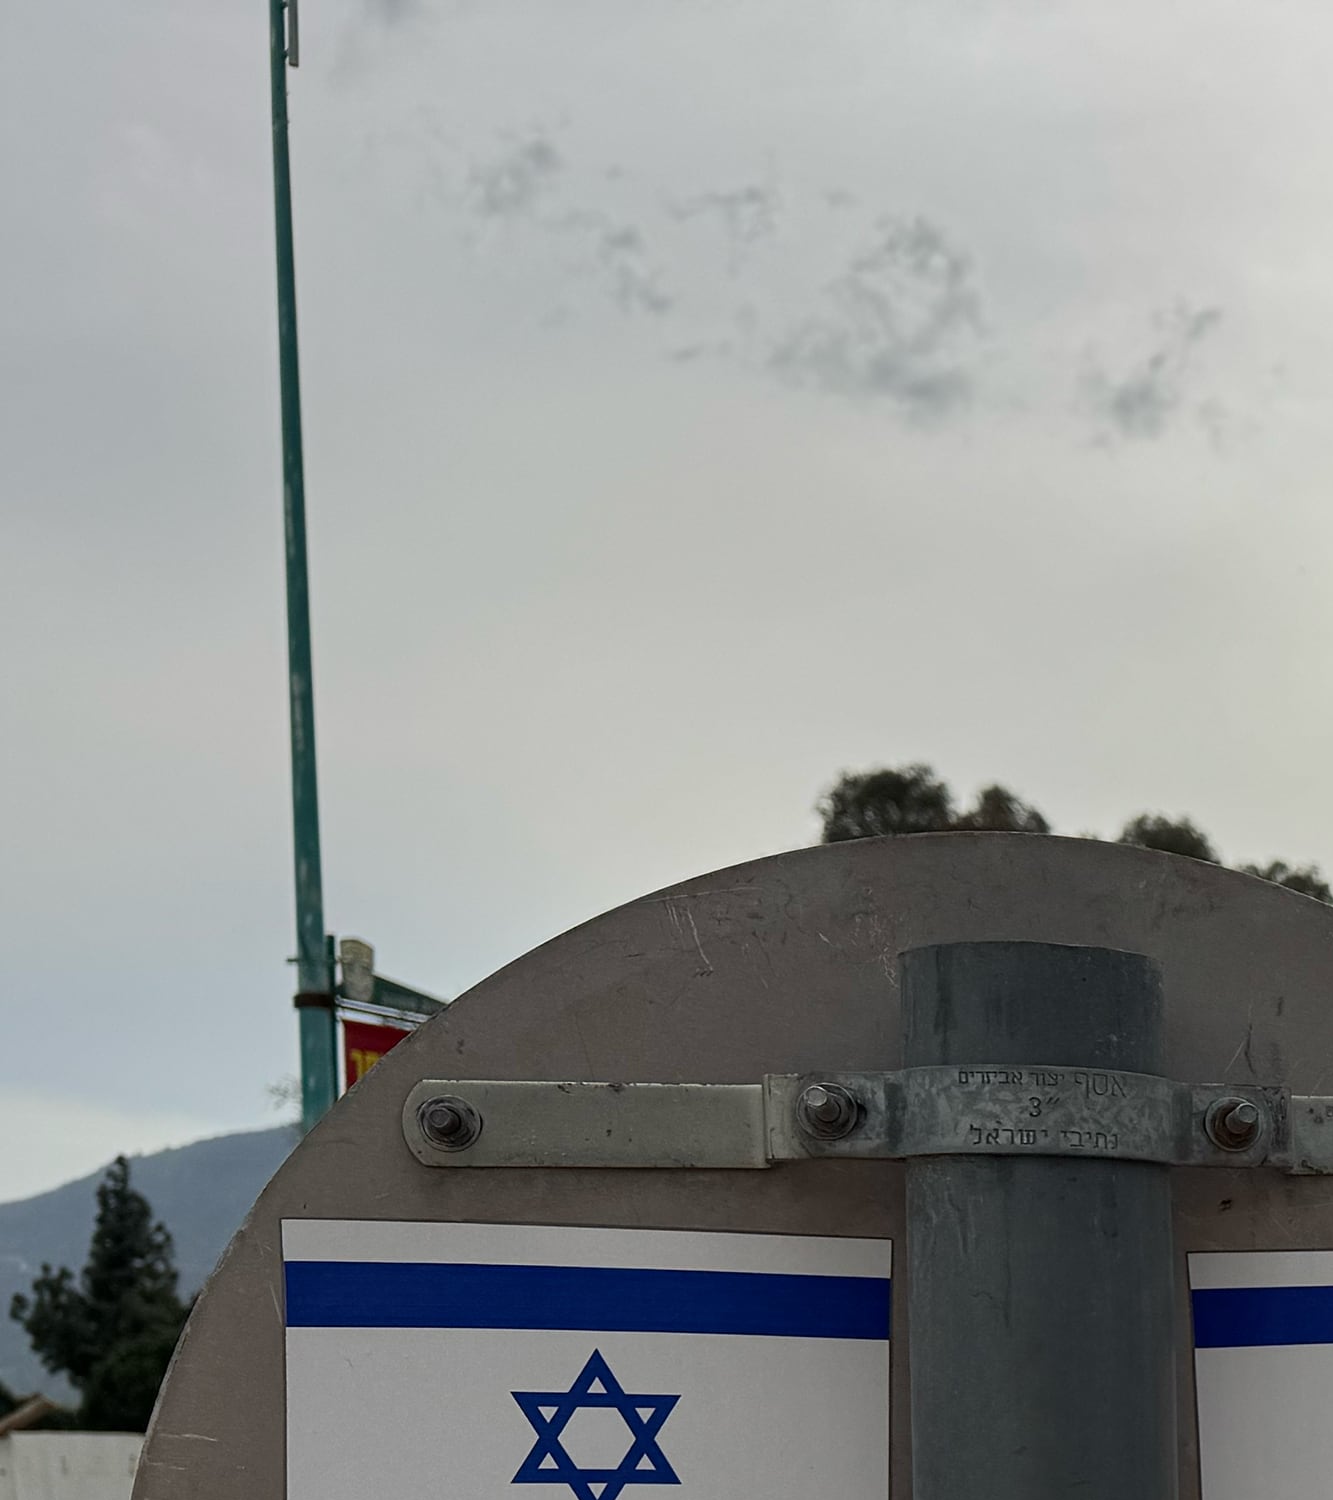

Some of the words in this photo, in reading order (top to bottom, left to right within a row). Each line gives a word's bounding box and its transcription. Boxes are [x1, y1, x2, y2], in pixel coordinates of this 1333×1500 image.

[1028, 1071, 1066, 1087] יצור
[1074, 1072, 1128, 1099] אסף
[968, 1123, 1051, 1147] ישראל
[1060, 1129, 1120, 1150] נתיבי
